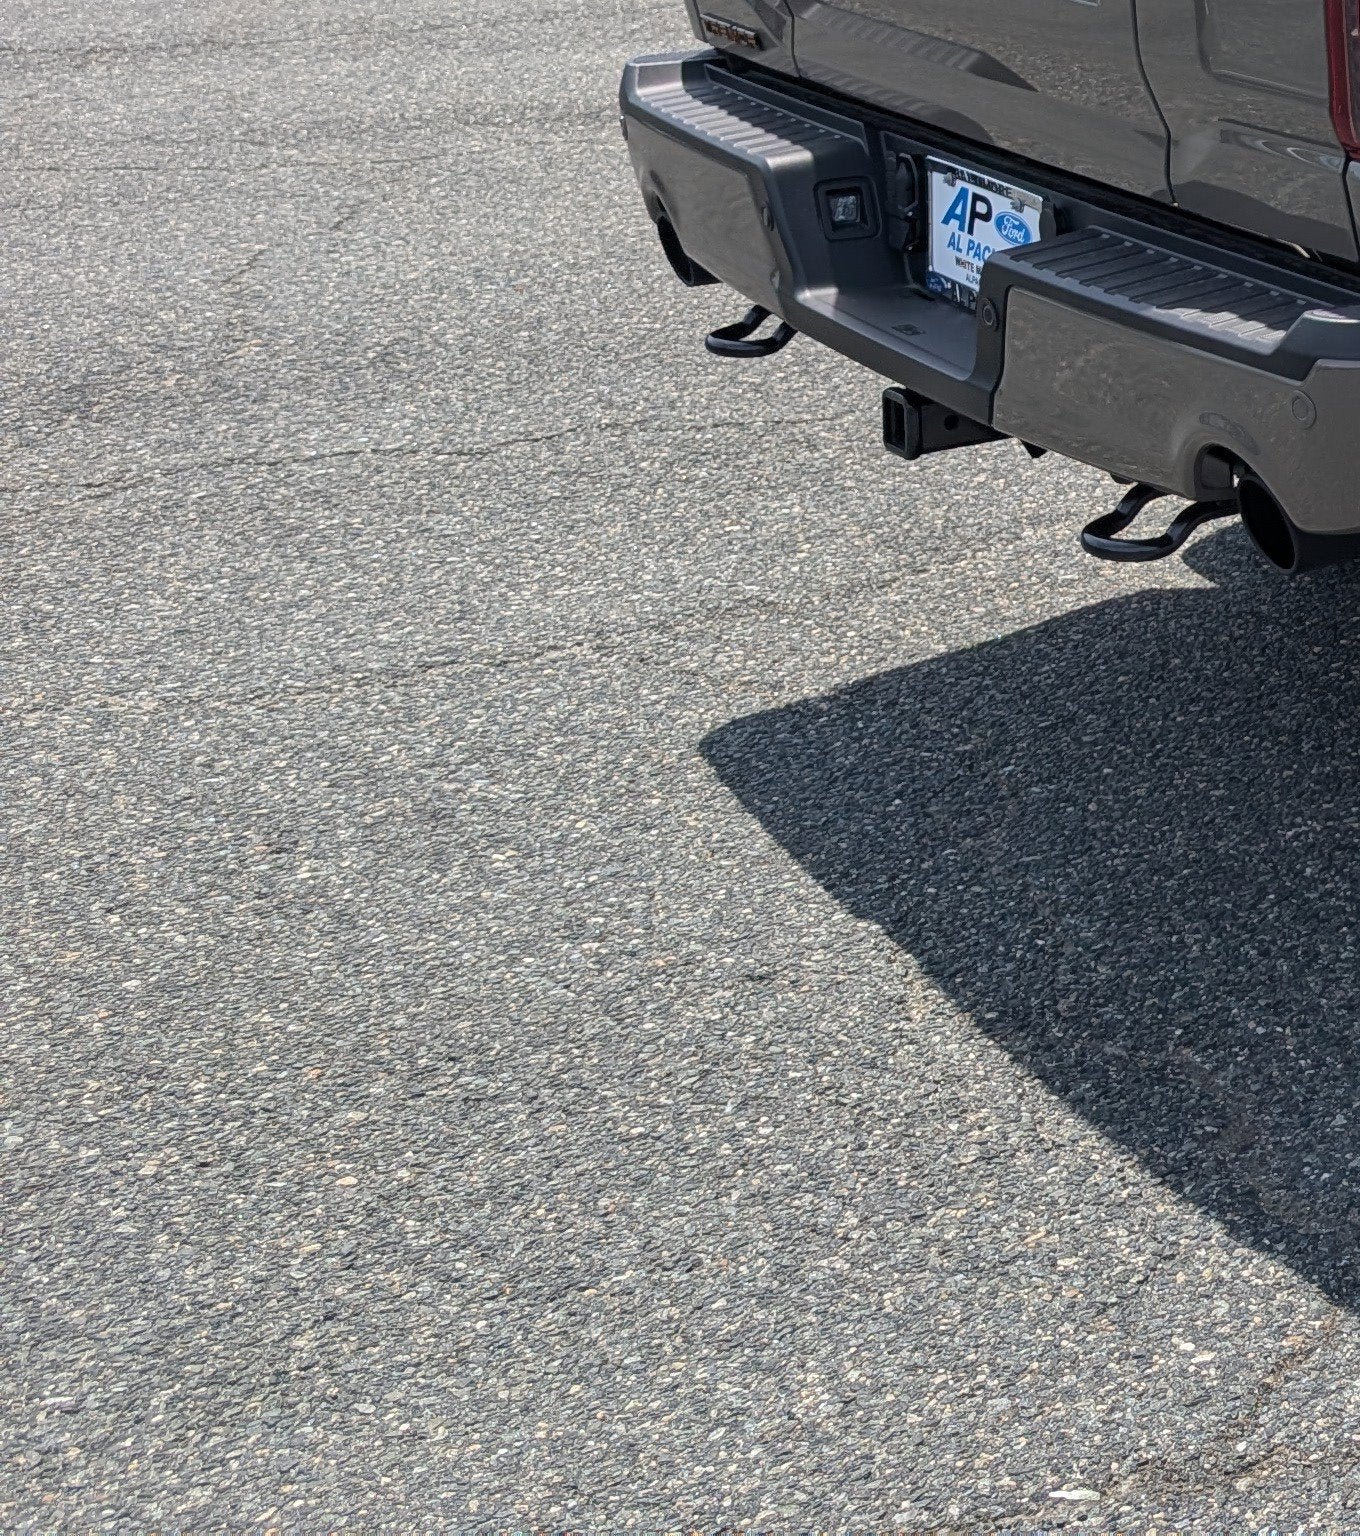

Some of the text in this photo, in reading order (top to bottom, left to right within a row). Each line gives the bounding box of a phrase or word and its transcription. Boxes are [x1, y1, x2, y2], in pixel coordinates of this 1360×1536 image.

[942, 187, 993, 236] AP
[1001, 214, 1027, 244] Ford
[947, 231, 996, 263] AL PAC
